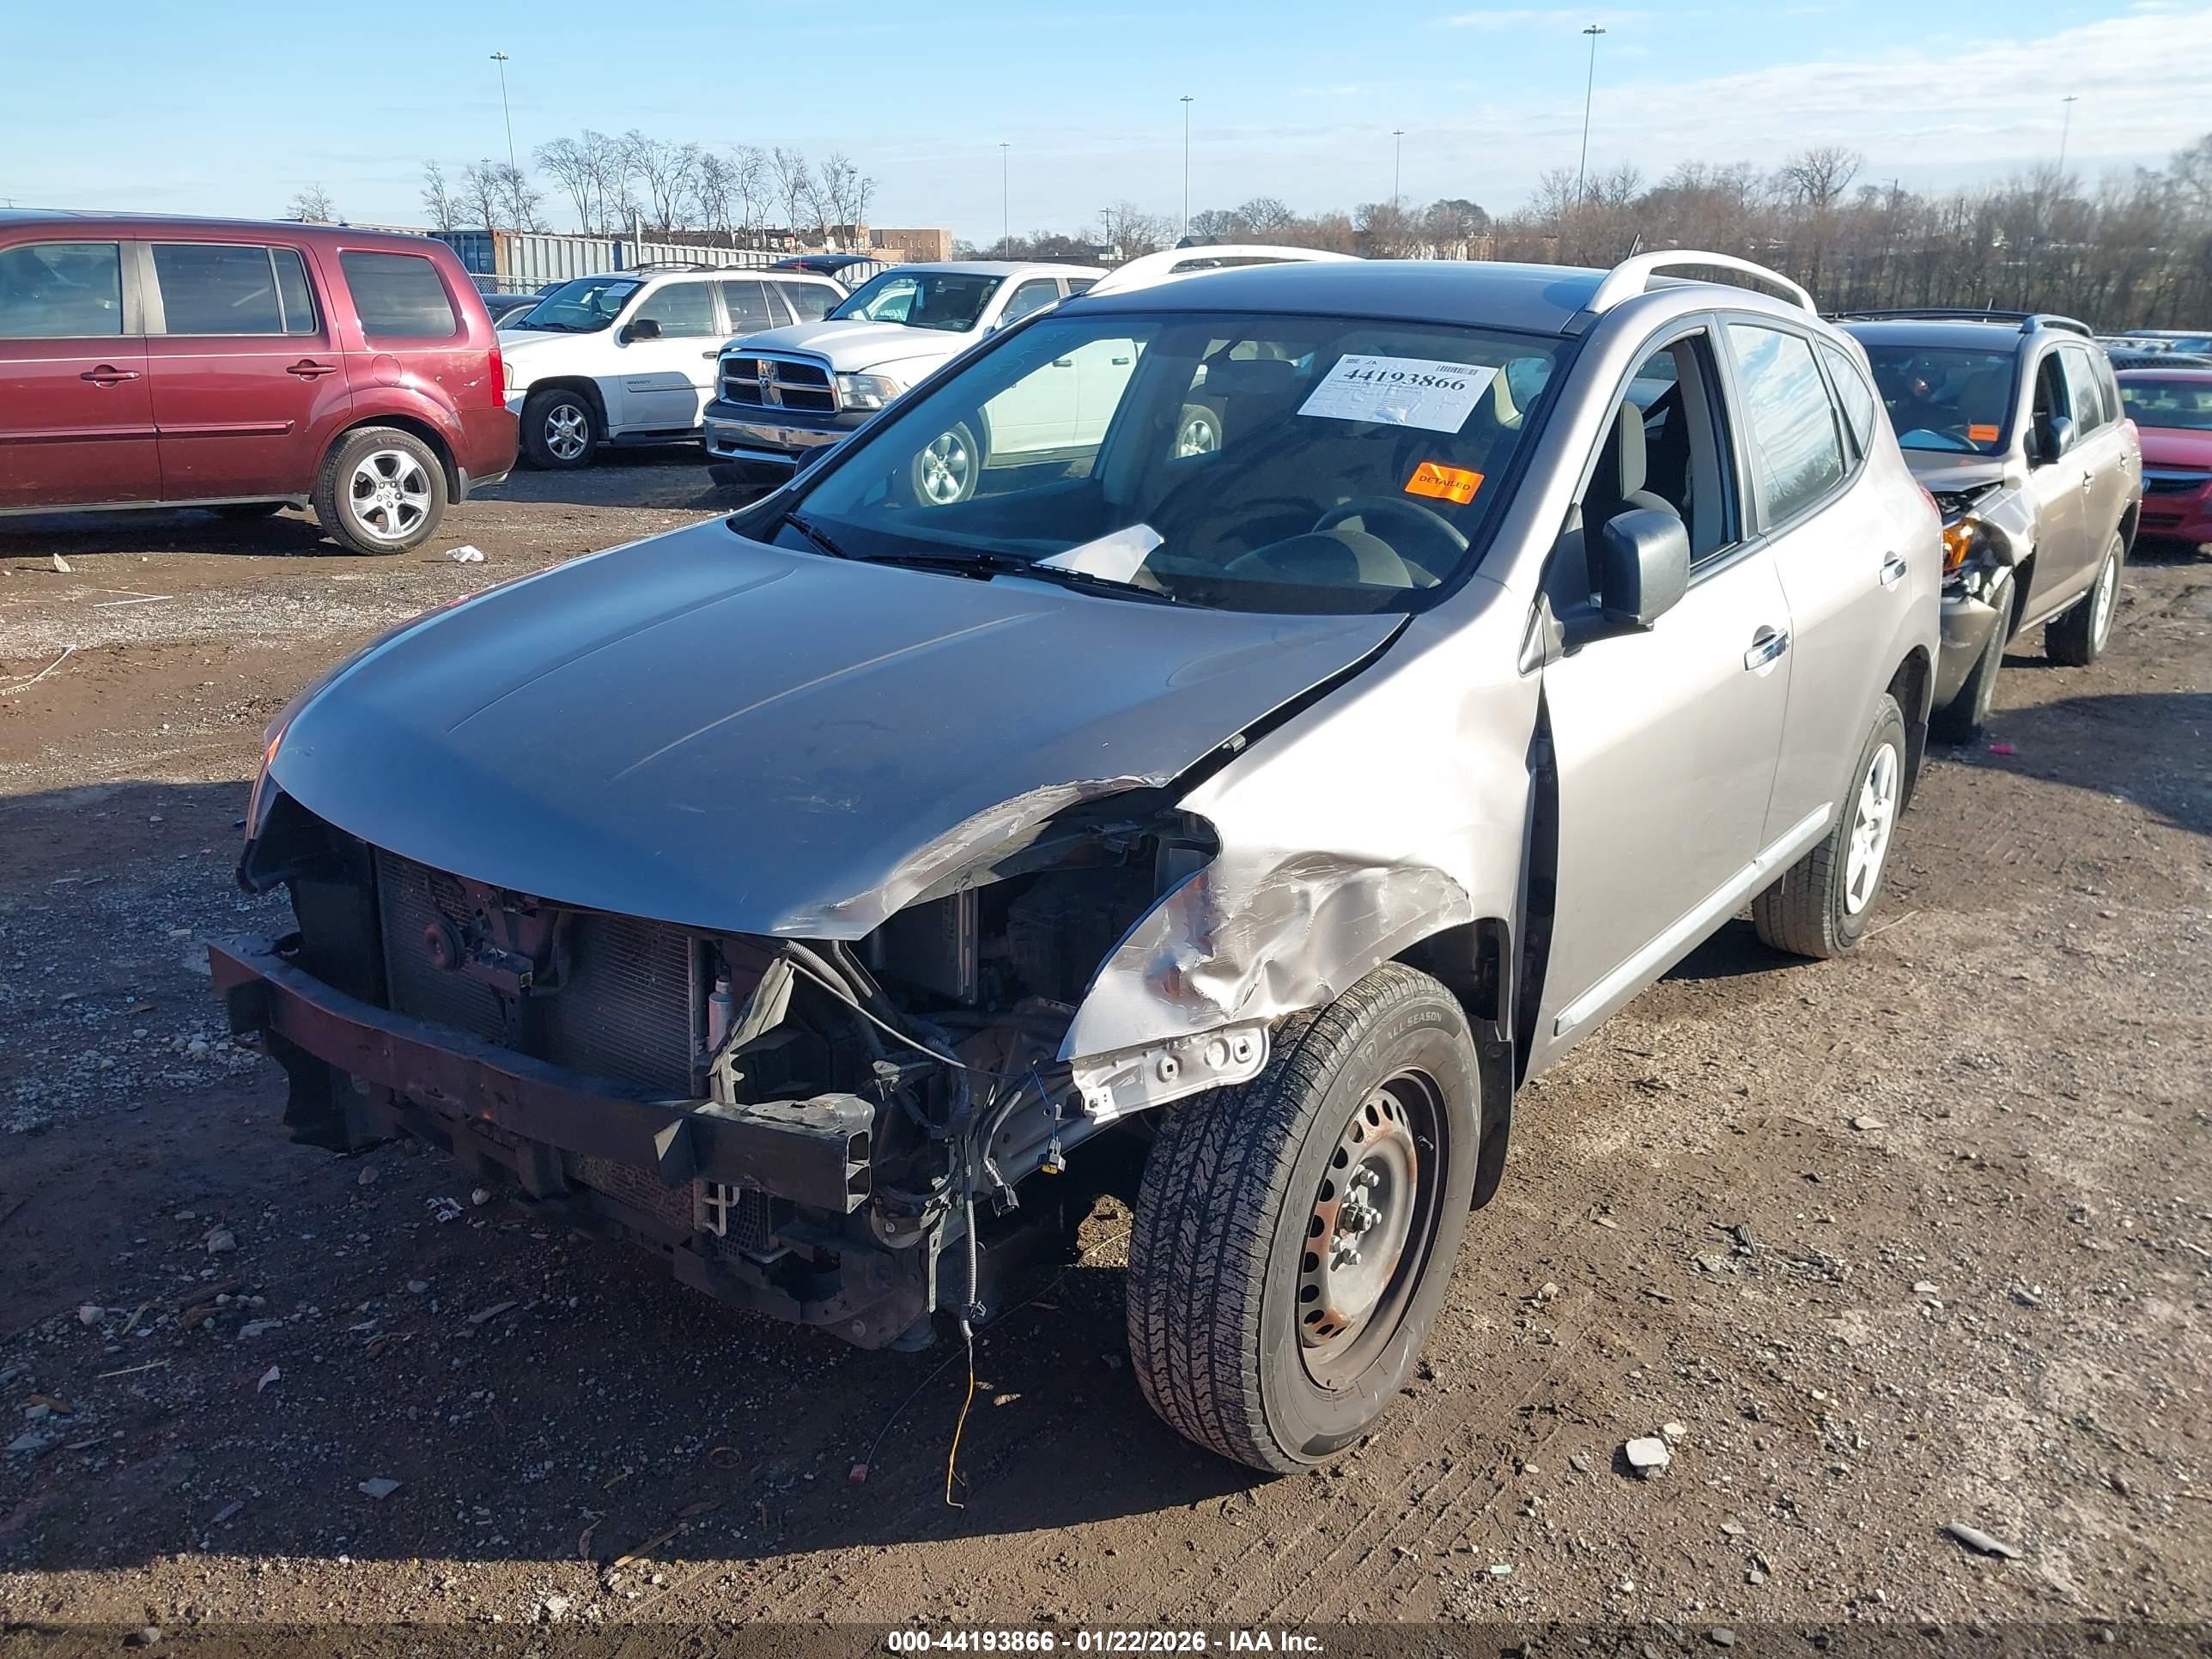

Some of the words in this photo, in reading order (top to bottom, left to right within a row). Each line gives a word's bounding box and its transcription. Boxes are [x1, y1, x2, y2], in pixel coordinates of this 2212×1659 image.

[1343, 368, 1467, 392] 44193866
[1419, 475, 1471, 491] DETAILED
[1407, 1012, 1443, 1028] SEASON
